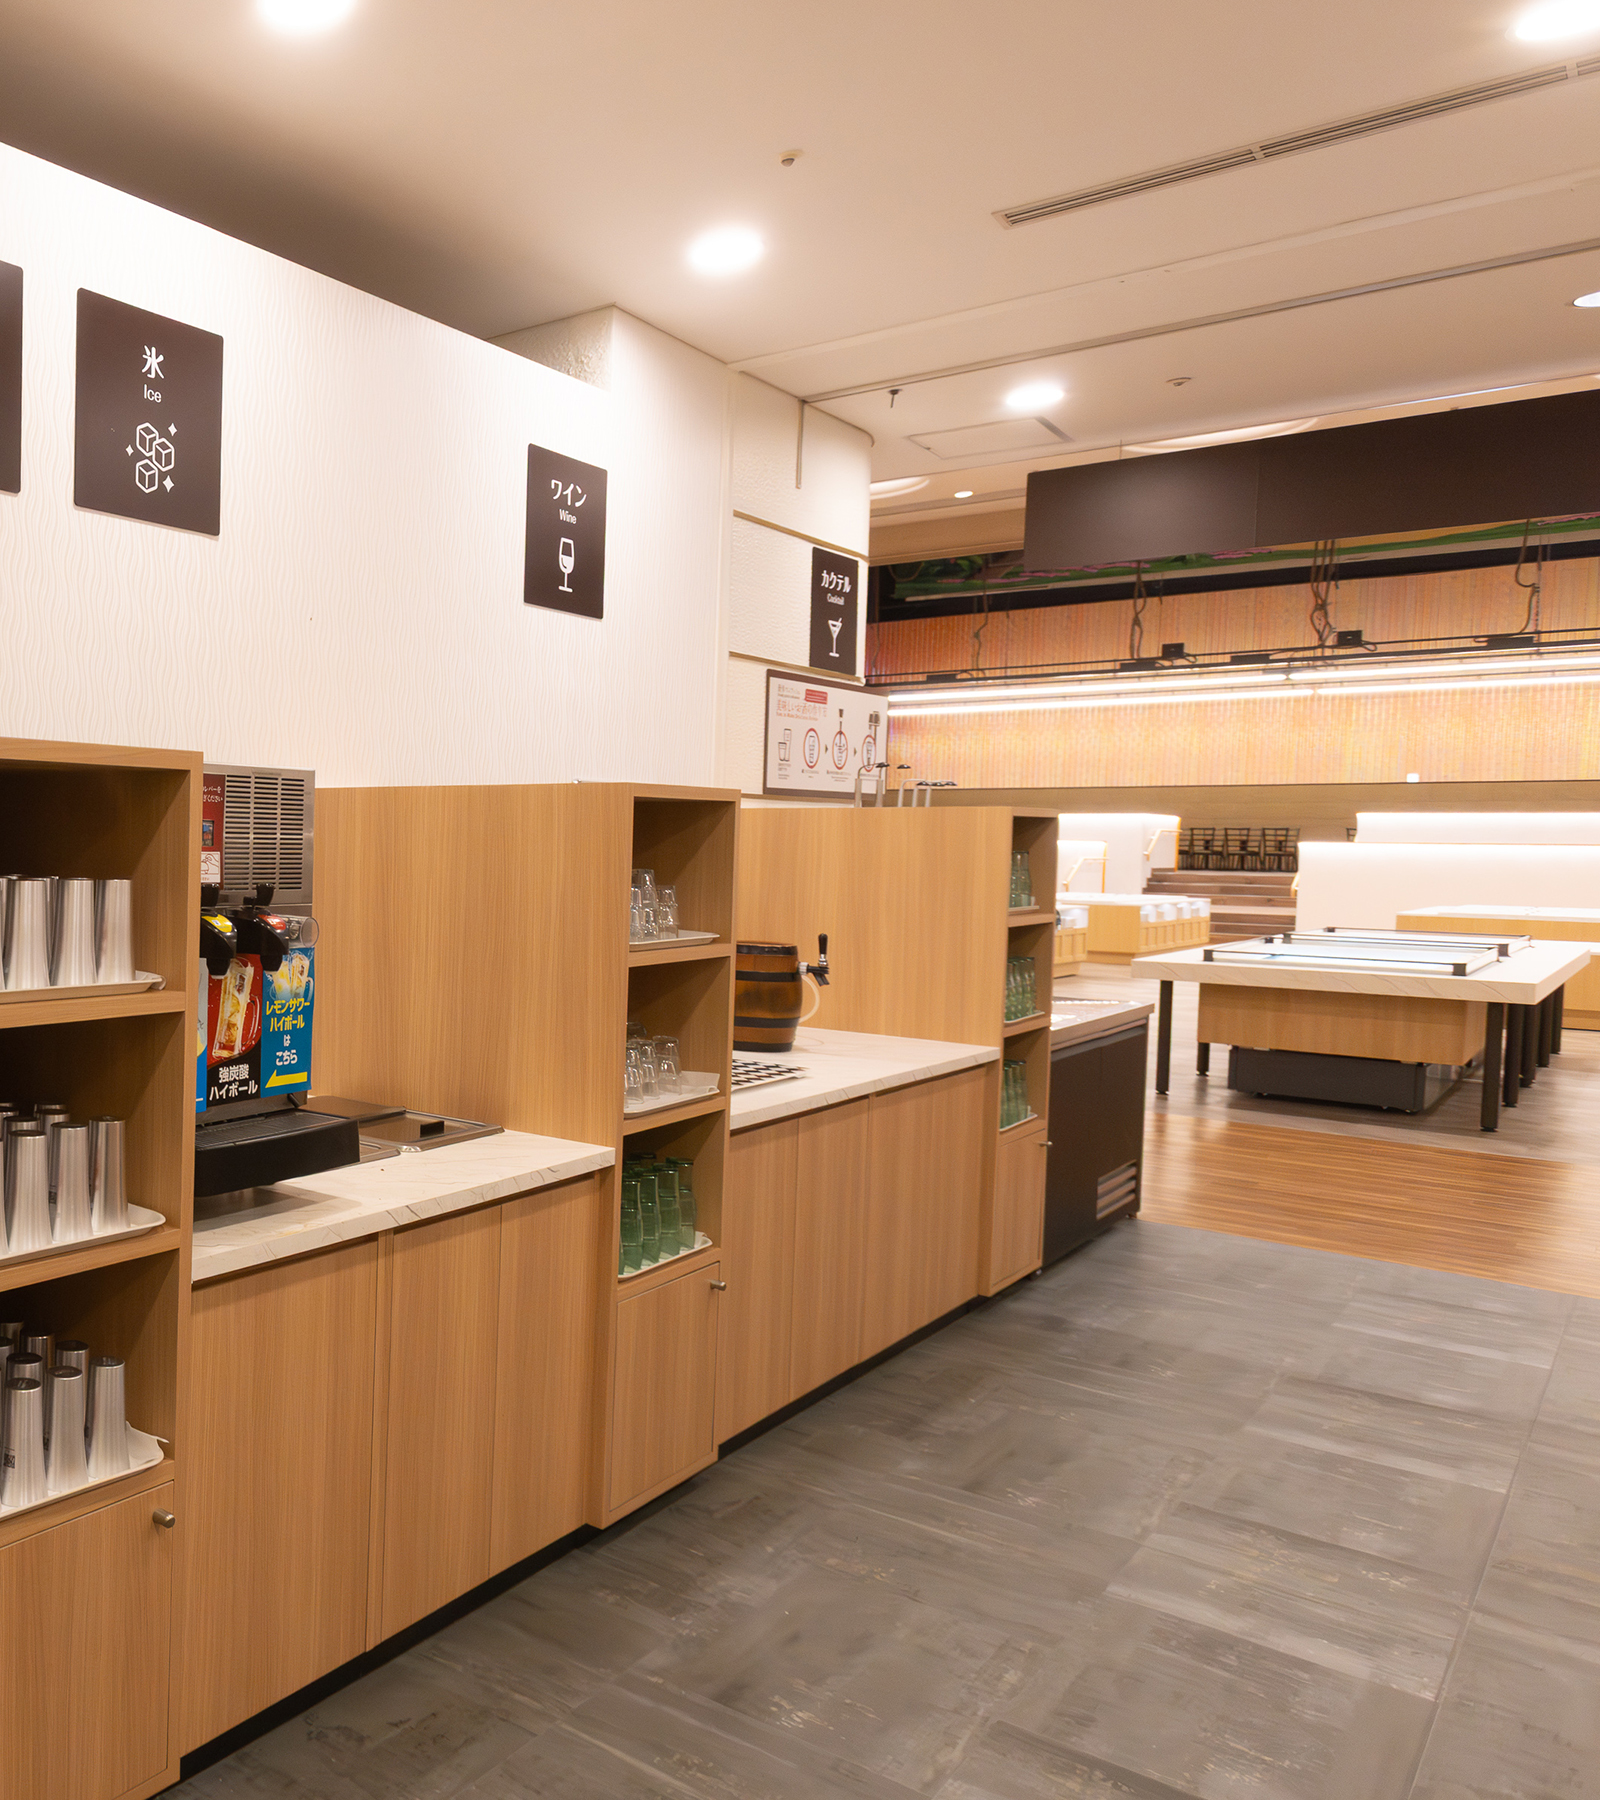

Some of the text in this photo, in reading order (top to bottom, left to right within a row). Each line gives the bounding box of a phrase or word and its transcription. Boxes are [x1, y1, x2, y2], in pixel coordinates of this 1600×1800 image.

[141, 344, 165, 380] 氷
[143, 384, 163, 403] Ice
[550, 479, 587, 508] ワイン
[559, 508, 577, 525] Wine
[820, 569, 852, 593] カクテル
[266, 998, 311, 1016] レモンサワー
[269, 1014, 306, 1033] ハイボール
[283, 1034, 291, 1047] は
[275, 1049, 299, 1067] こちら
[218, 1063, 250, 1084] 強炭酸
[209, 1080, 259, 1101] ハイボール
